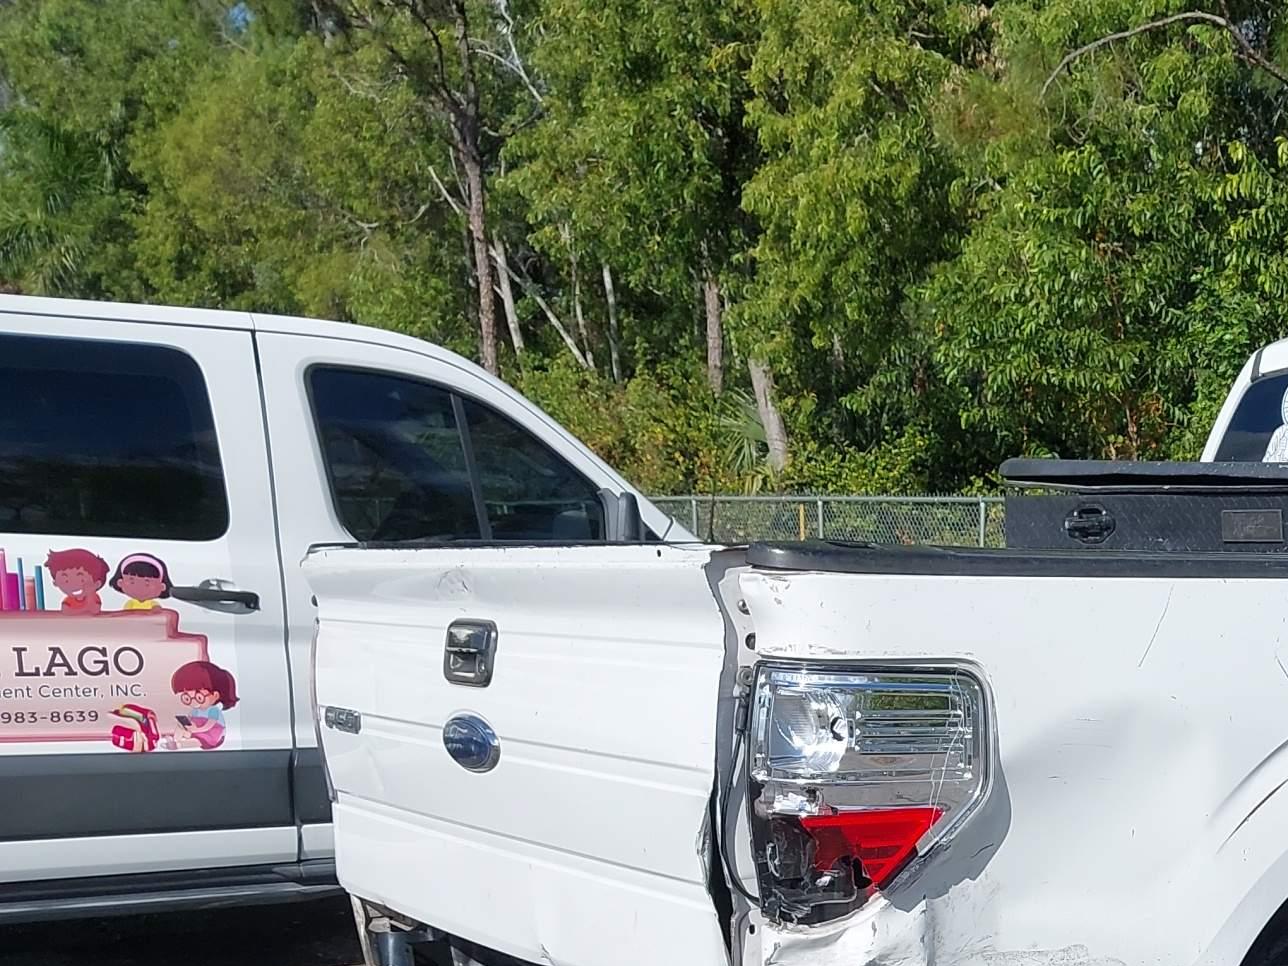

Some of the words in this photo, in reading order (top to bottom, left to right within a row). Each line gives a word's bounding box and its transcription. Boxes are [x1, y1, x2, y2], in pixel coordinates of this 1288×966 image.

[12, 646, 144, 677] LAGO
[0, 685, 32, 699] ent
[39, 684, 104, 699] Center,
[110, 684, 147, 697] INC.
[0, 710, 98, 724] 983-8639
